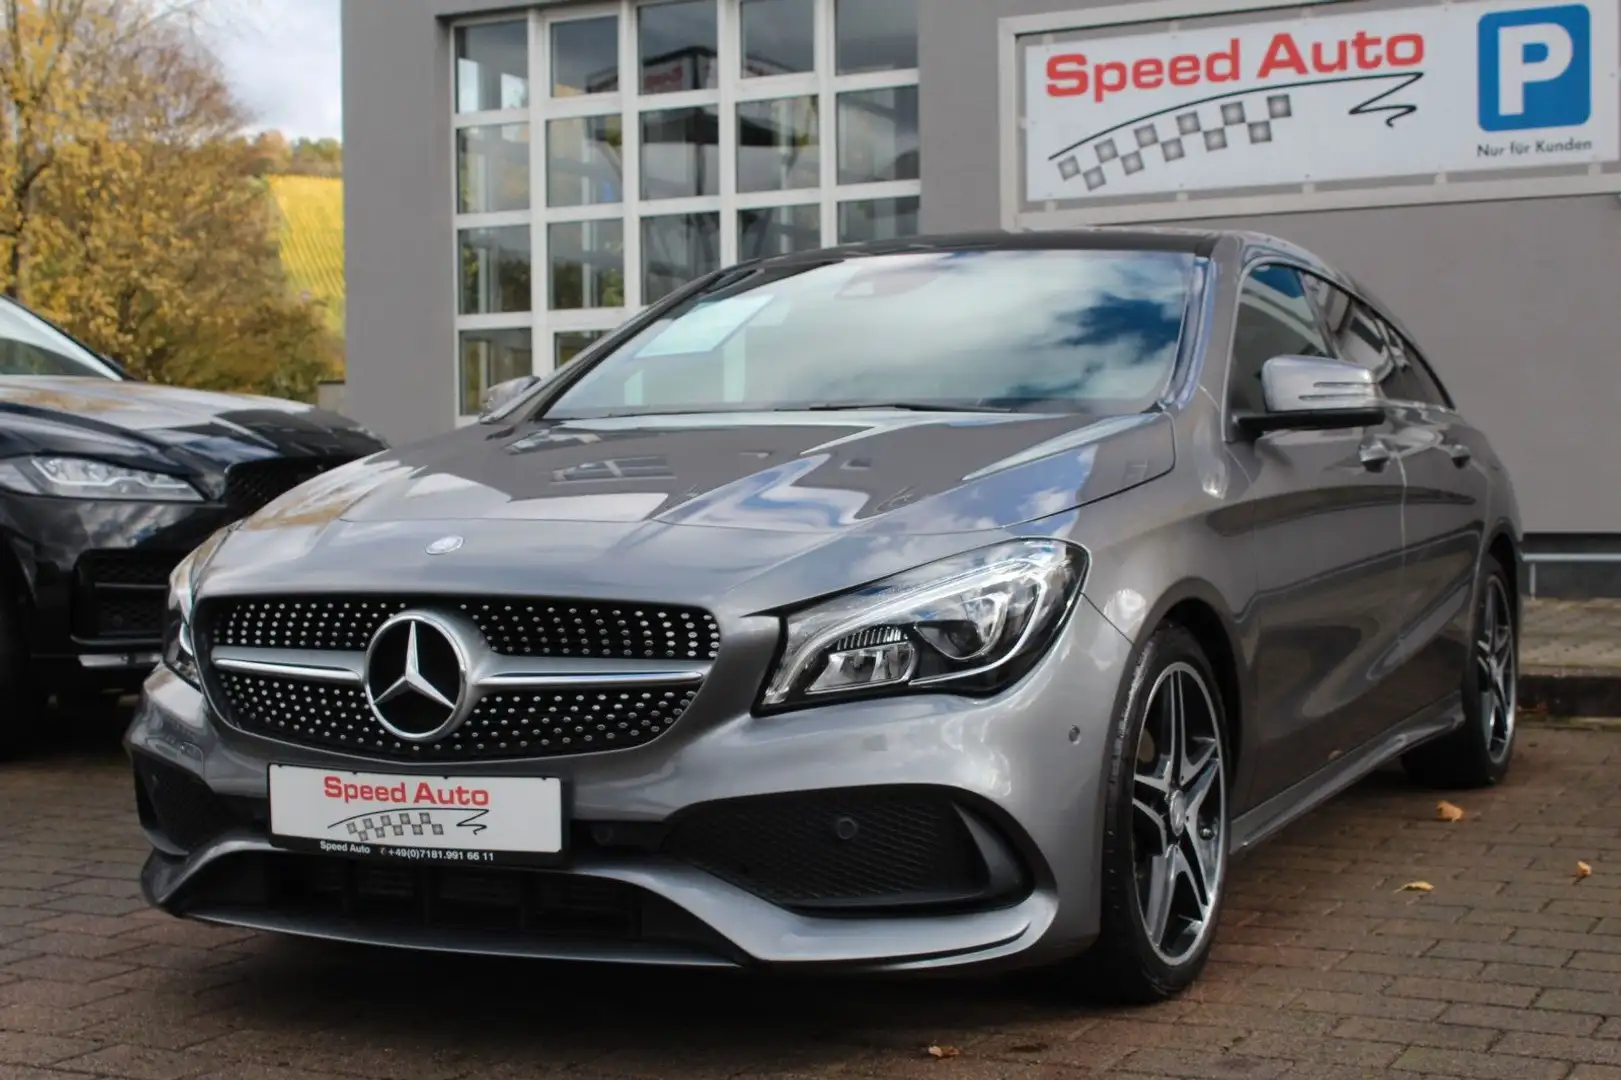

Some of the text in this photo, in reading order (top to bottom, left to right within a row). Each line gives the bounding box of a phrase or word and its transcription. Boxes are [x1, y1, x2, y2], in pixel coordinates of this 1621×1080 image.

[1046, 31, 1424, 102] Speed Auto
[1498, 22, 1574, 117] P
[1477, 136, 1593, 157] Nur für Kunden
[324, 775, 490, 806] Speed Auto
[319, 840, 348, 853] Speed
[350, 845, 371, 855] Auto
[483, 852, 494, 861] 11
